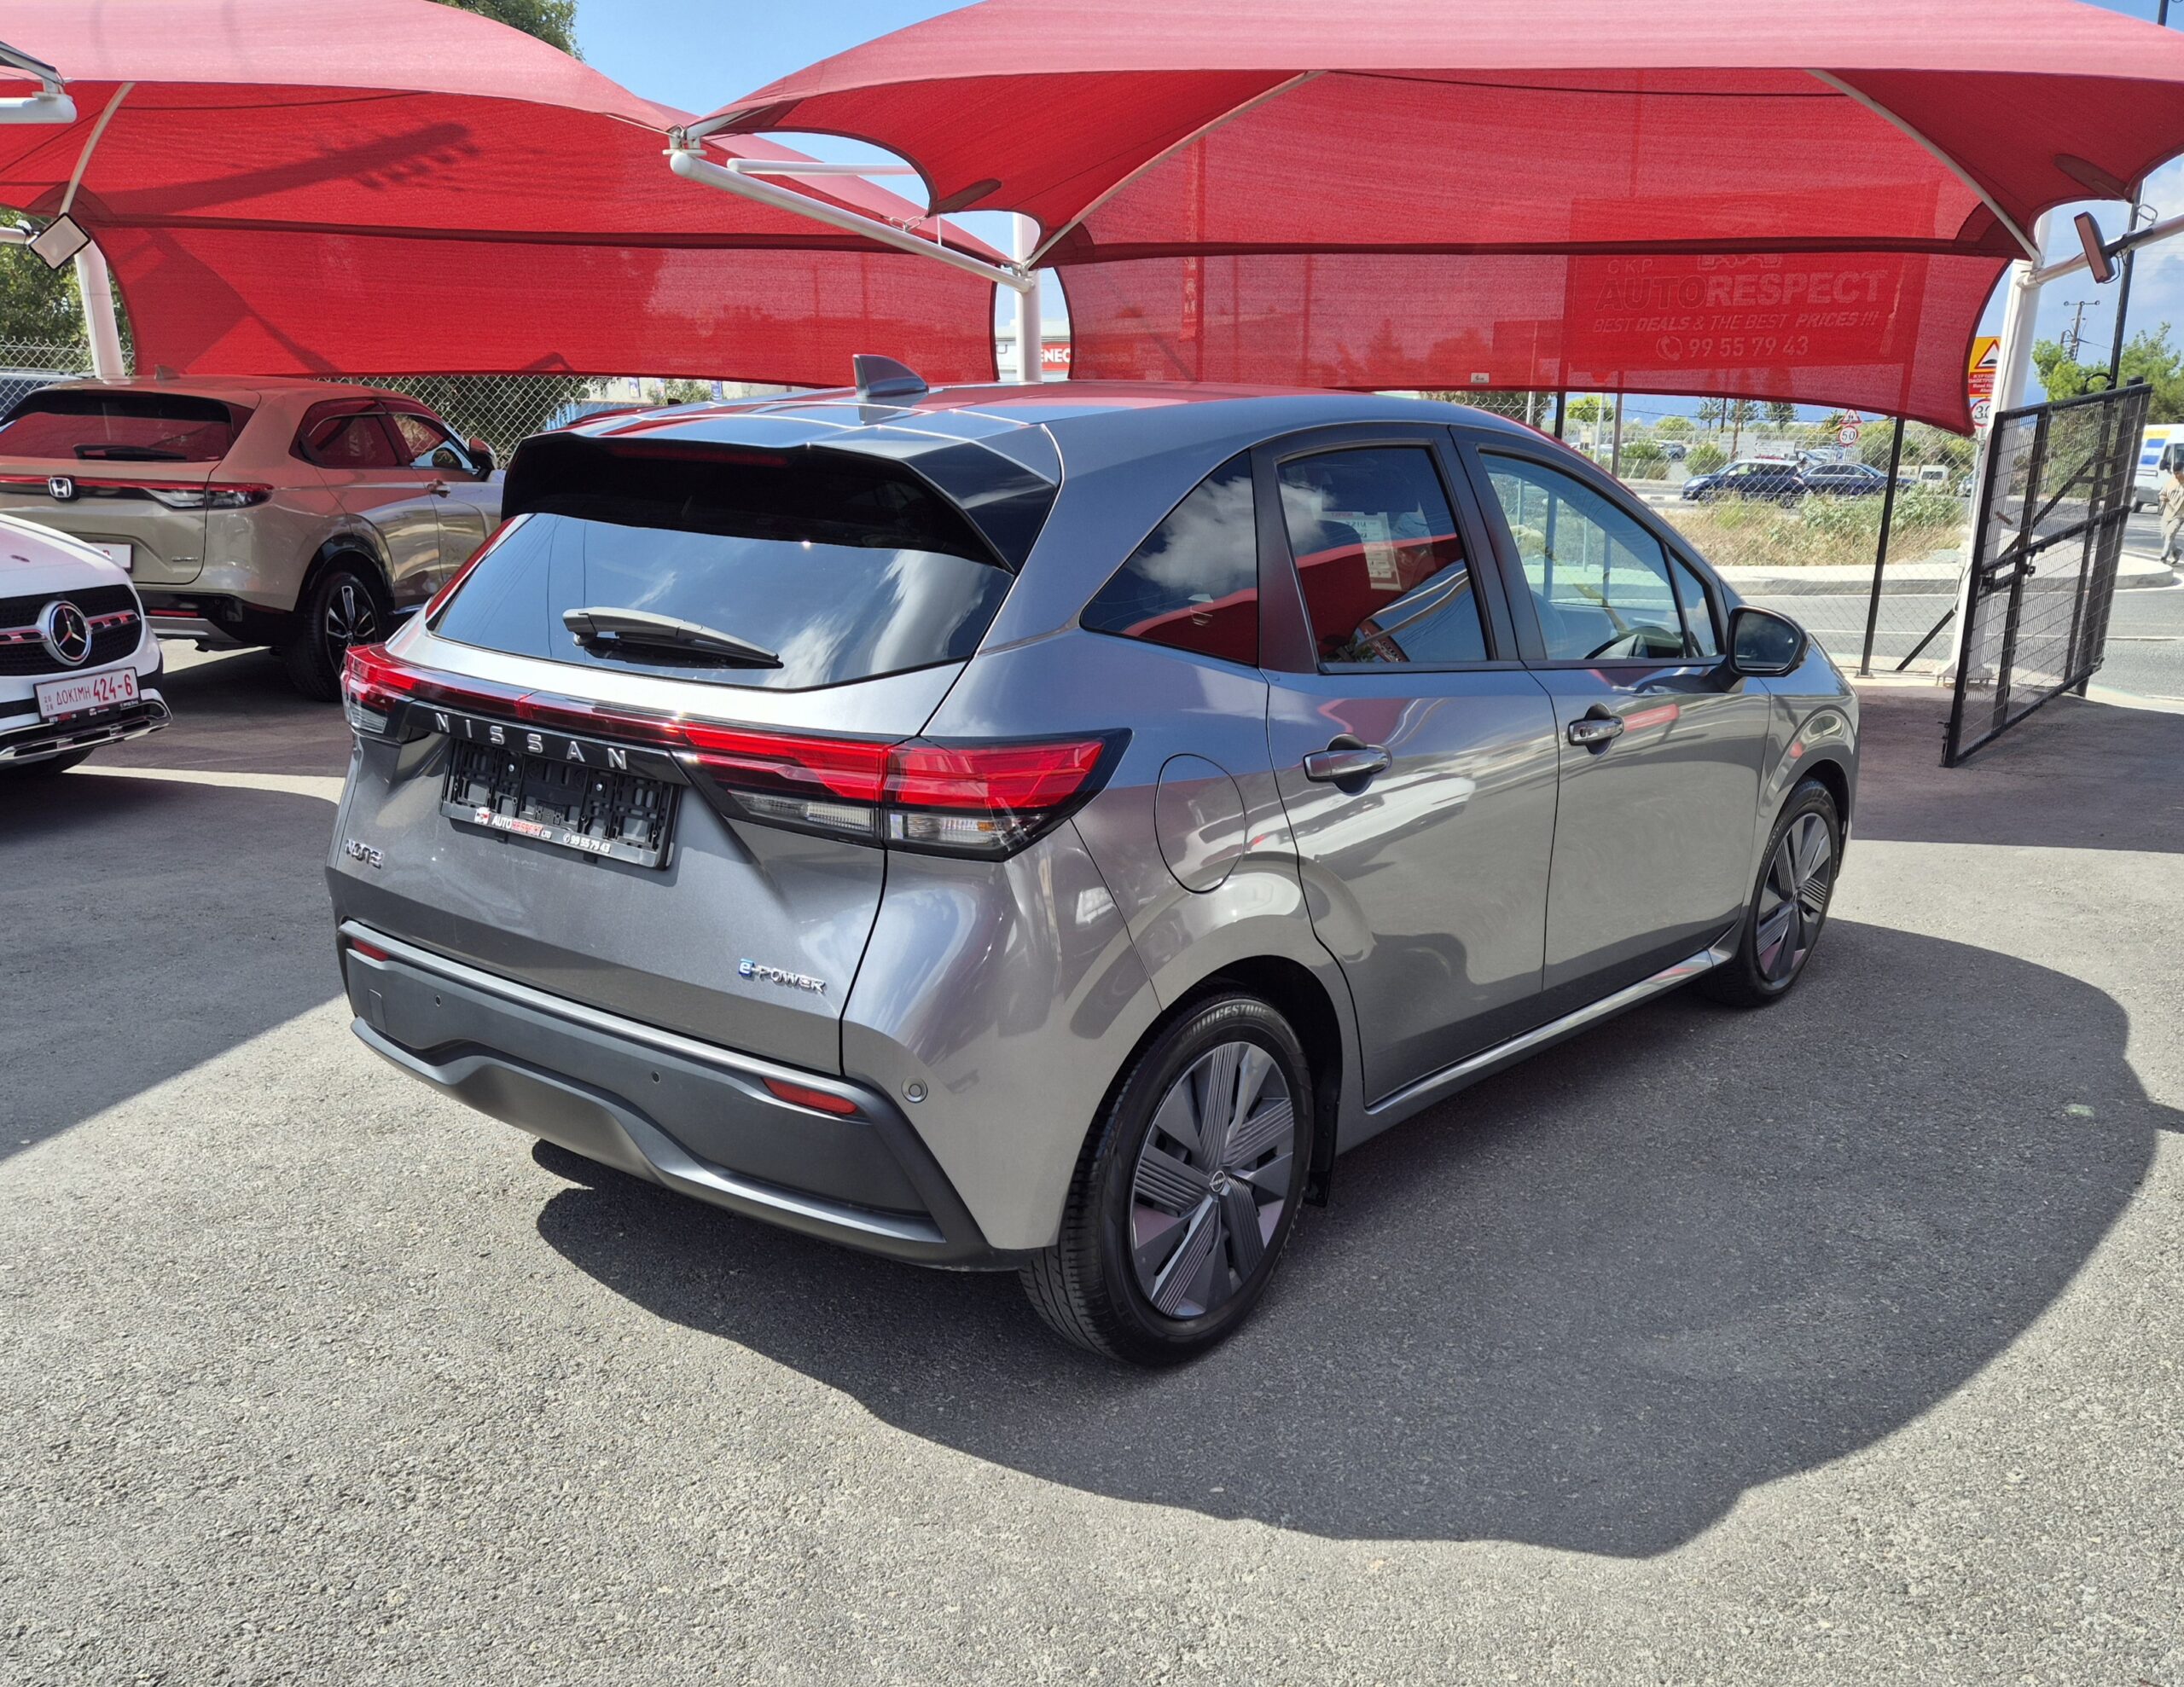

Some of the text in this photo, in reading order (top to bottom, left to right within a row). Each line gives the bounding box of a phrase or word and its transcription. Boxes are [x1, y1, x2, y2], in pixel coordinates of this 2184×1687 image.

[1594, 269, 1890, 311] AUTORESPECT
[1593, 318, 1635, 333] BEST
[1635, 316, 1692, 332] DEALS
[1693, 316, 1704, 331] &
[1710, 315, 1743, 330] THE
[1745, 314, 1789, 329] BEST
[1688, 335, 1809, 358] 99 55 79 43
[1842, 430, 1856, 441] 50
[56, 686, 91, 705] ΔΟΚΙΜΗ
[93, 674, 133, 702] 424-6
[435, 712, 627, 770] NISSAN
[345, 838, 384, 869] NOTE
[739, 958, 827, 994] e-POWER
